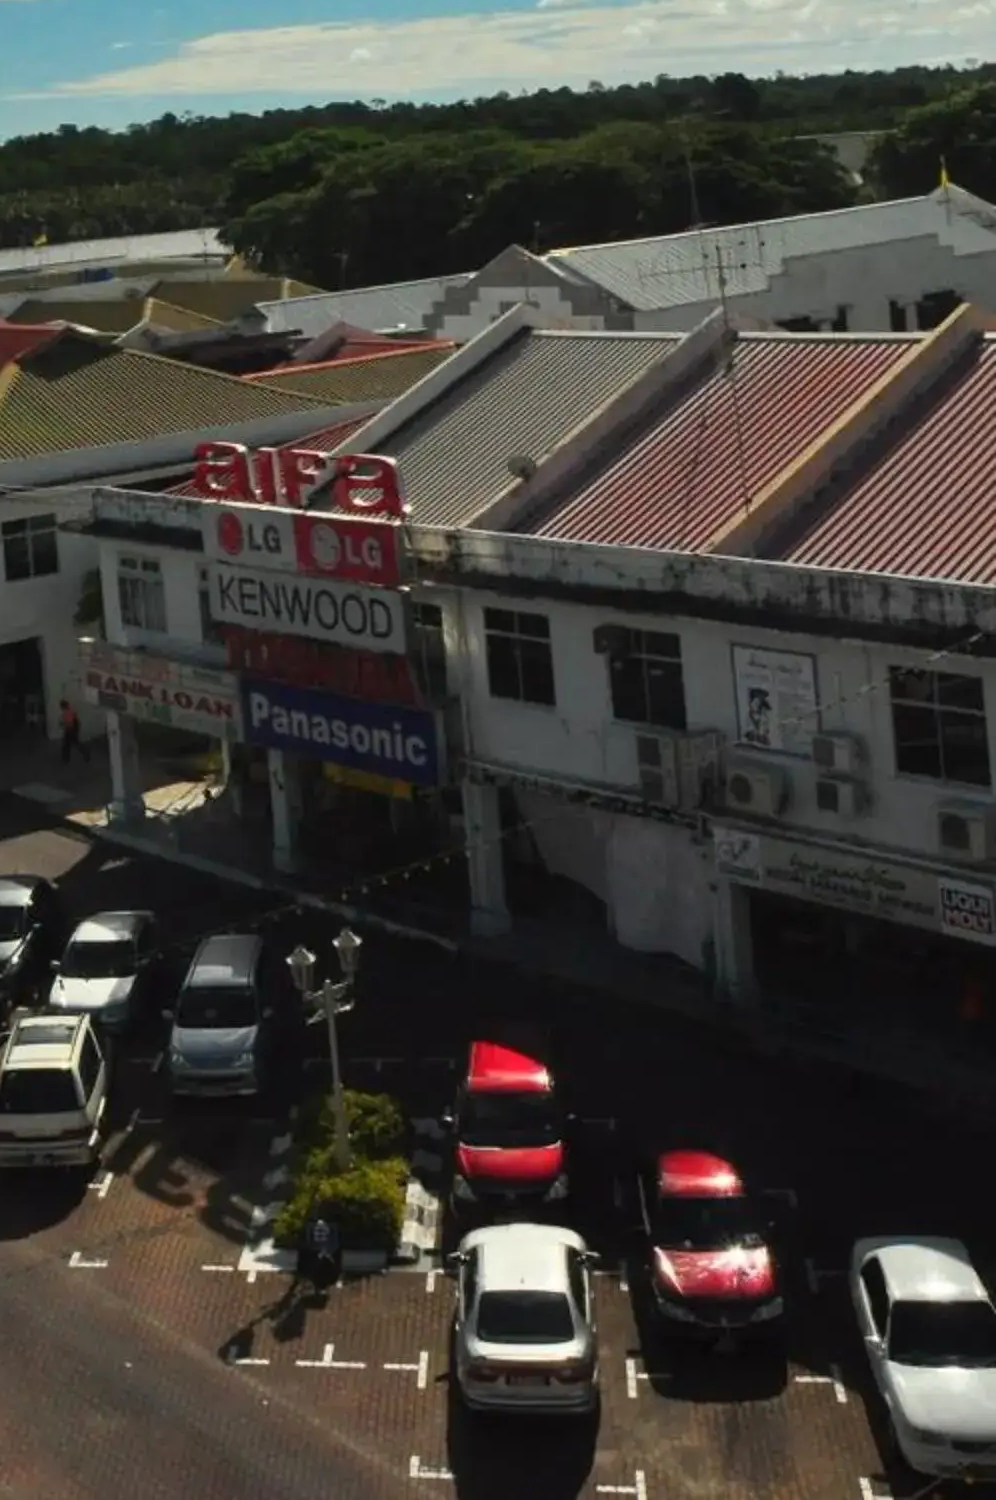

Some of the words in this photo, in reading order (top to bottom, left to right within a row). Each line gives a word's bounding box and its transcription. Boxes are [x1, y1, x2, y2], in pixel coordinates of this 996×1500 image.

[248, 525, 282, 554] LG
[346, 535, 383, 568] LG
[218, 573, 393, 640] KENWOOD
[87, 670, 154, 700] BANK
[160, 688, 234, 718] LOAN
[250, 693, 428, 767] Panasonic
[945, 908, 992, 933] MOLY
